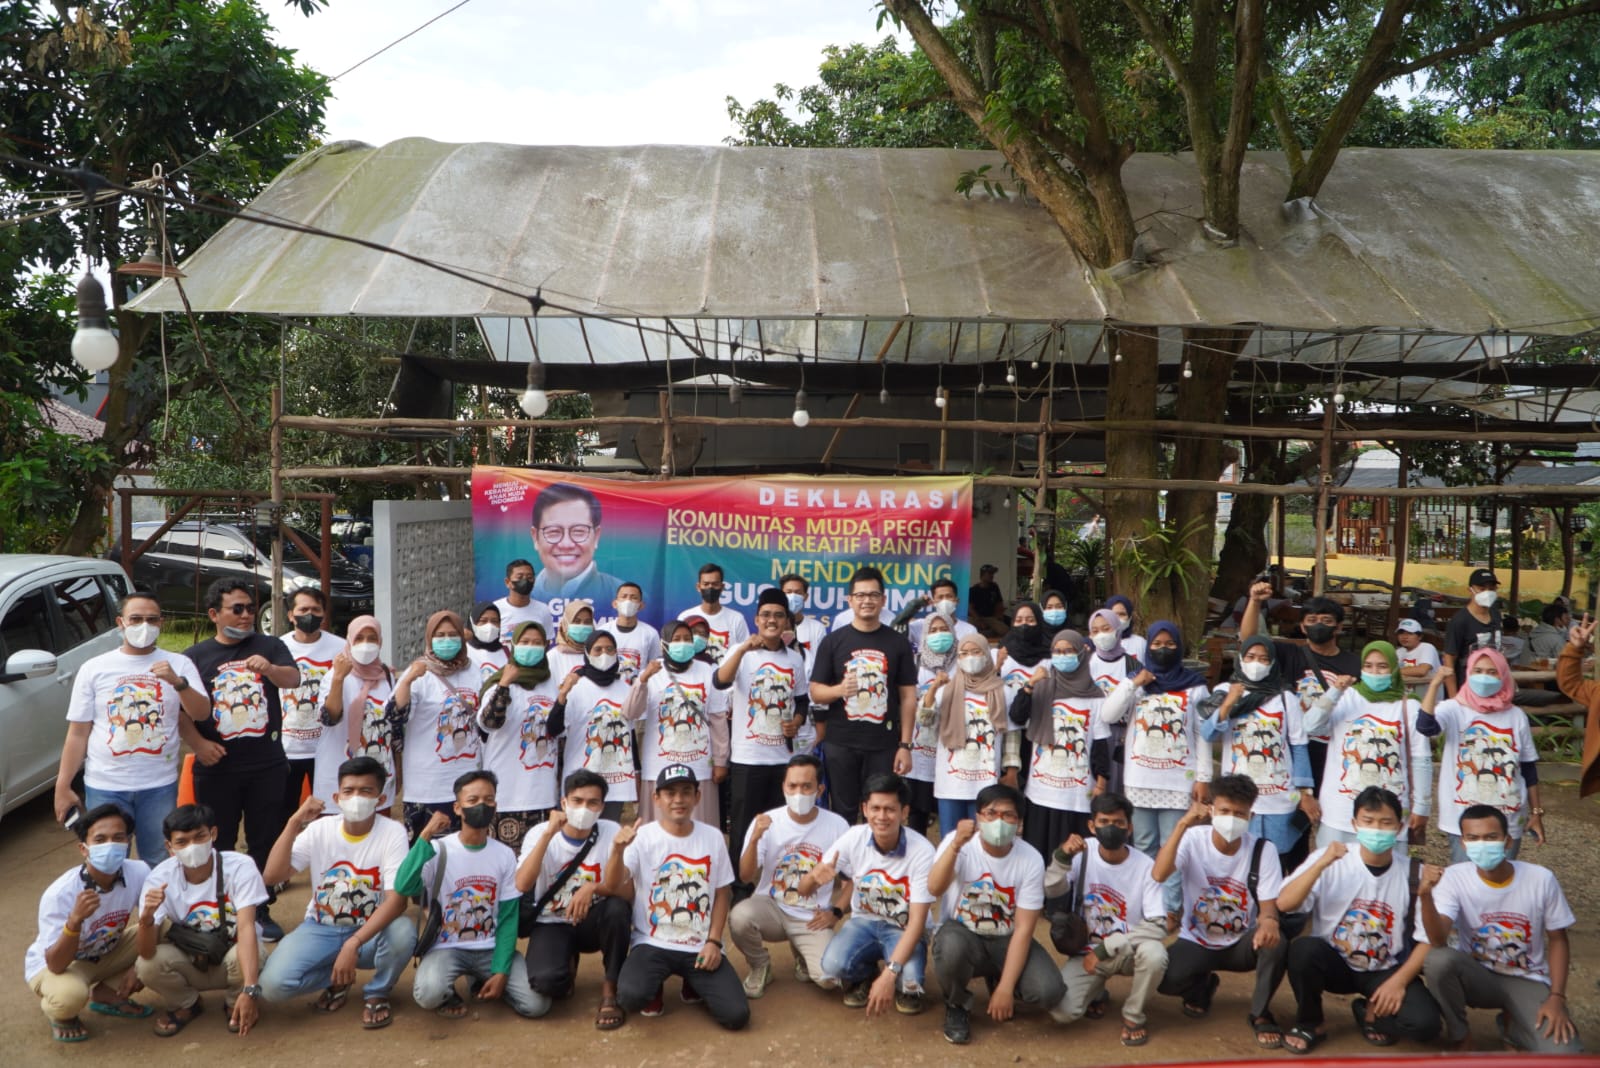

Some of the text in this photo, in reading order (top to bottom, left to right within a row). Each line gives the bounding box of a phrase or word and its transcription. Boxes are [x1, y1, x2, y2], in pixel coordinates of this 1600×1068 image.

[491, 495, 524, 505] INDONESIA
[759, 487, 958, 509] DEKLARASI
[667, 508, 954, 538] KOMUNITAS MUDA PEGIAT
[667, 527, 952, 556] EKONOMI KREATIF BANTEN
[771, 558, 952, 586] MENDKUNG
